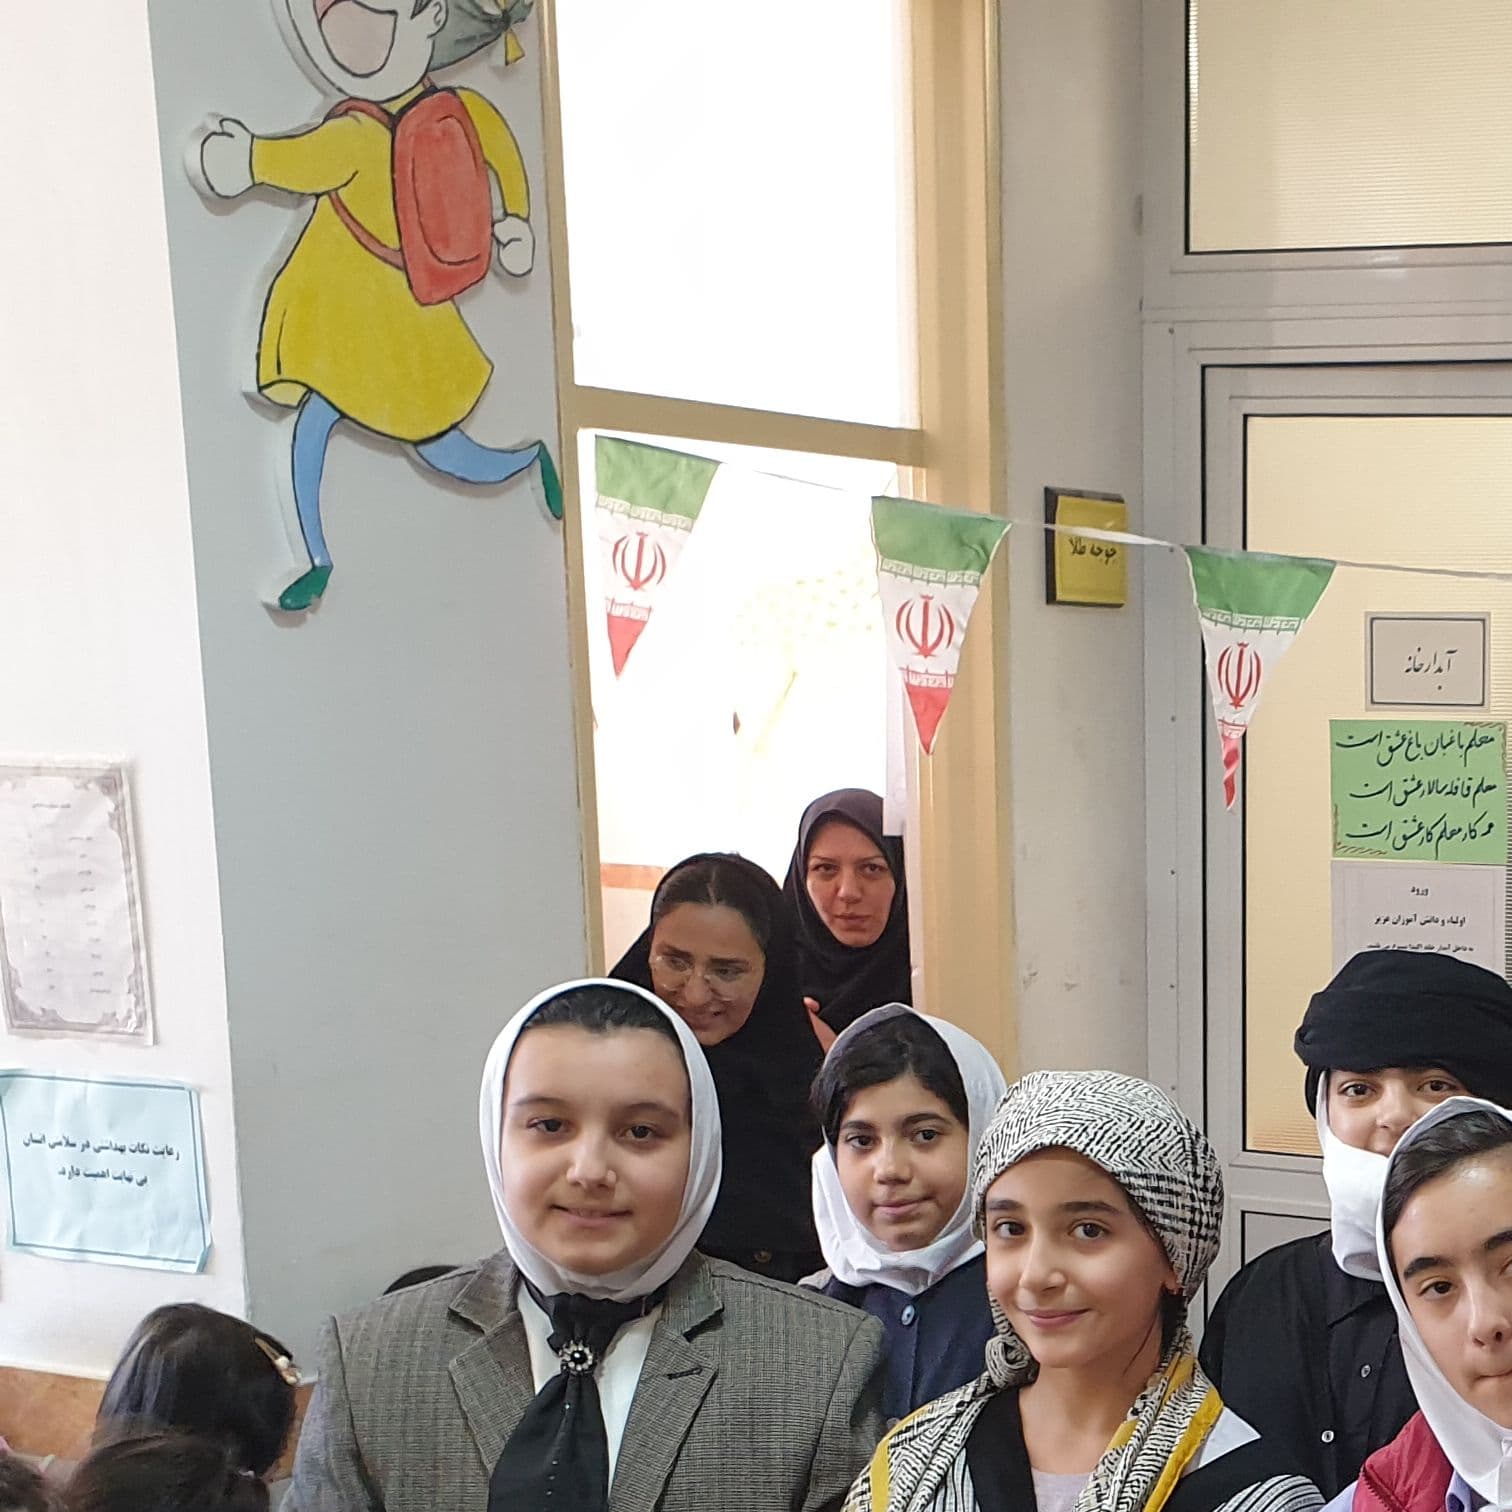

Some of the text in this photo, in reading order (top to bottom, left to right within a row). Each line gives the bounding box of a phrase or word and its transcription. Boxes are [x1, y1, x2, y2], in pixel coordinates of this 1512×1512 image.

[1404, 646, 1459, 691] آبدارخانه
[1335, 729, 1384, 749] است
[1376, 728, 1408, 768] عشق
[1404, 729, 1424, 762] باغ
[1463, 727, 1496, 768] معلم
[1349, 779, 1393, 802] است
[1392, 773, 1424, 808] عشق
[1471, 775, 1498, 810] معلم
[1344, 819, 1393, 843] است
[1391, 814, 1426, 852] عشق
[1435, 819, 1464, 861] معلم
[1410, 885, 1429, 897] ورود
[22, 1132, 46, 1147] انسان
[79, 1139, 91, 1153] در
[128, 1141, 151, 1155] نکات
[152, 1144, 180, 1160] رعایت
